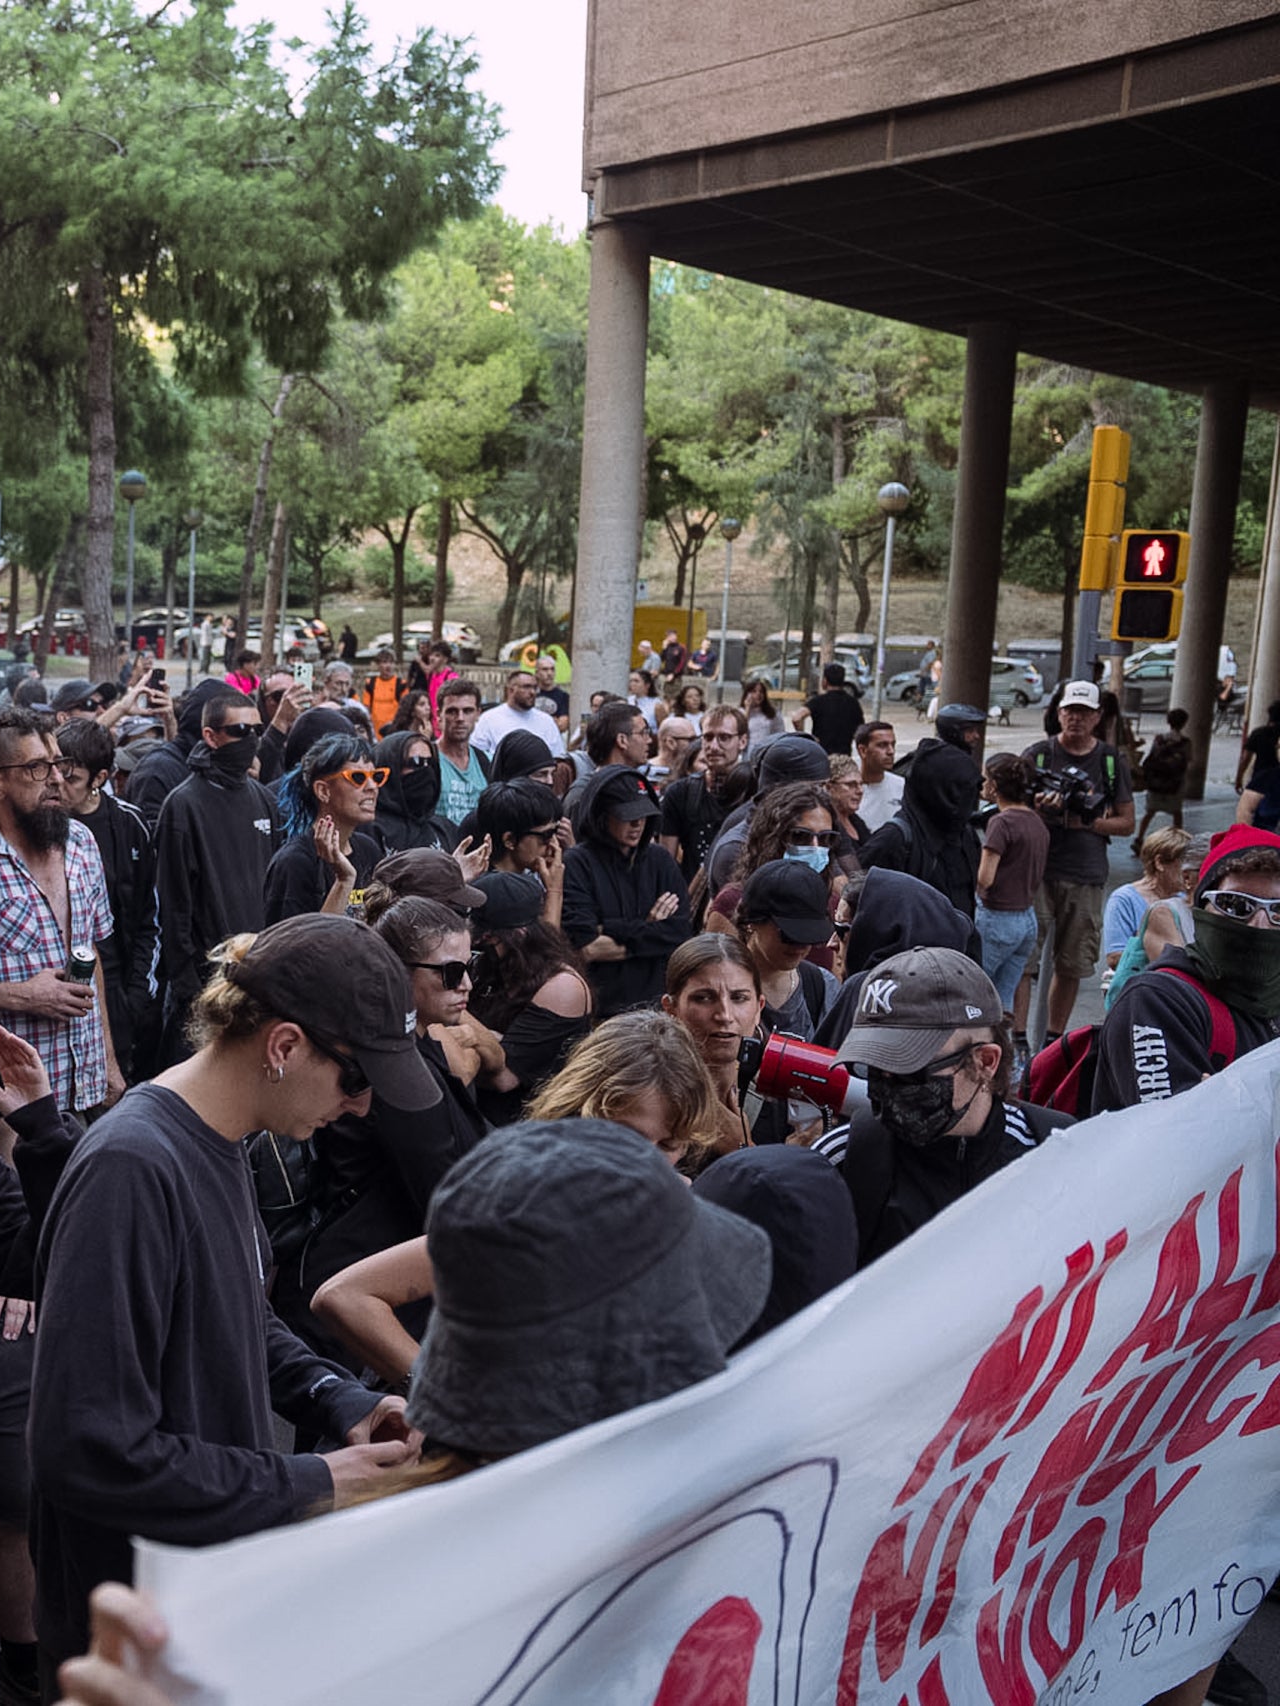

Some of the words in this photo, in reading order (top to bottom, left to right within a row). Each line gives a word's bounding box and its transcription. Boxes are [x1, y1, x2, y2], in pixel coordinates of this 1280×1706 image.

[892, 1227, 1129, 1508] NI
[835, 1452, 1013, 1706] NI
[976, 1464, 1202, 1706] VOX
[1120, 1602, 1197, 1662] fem
